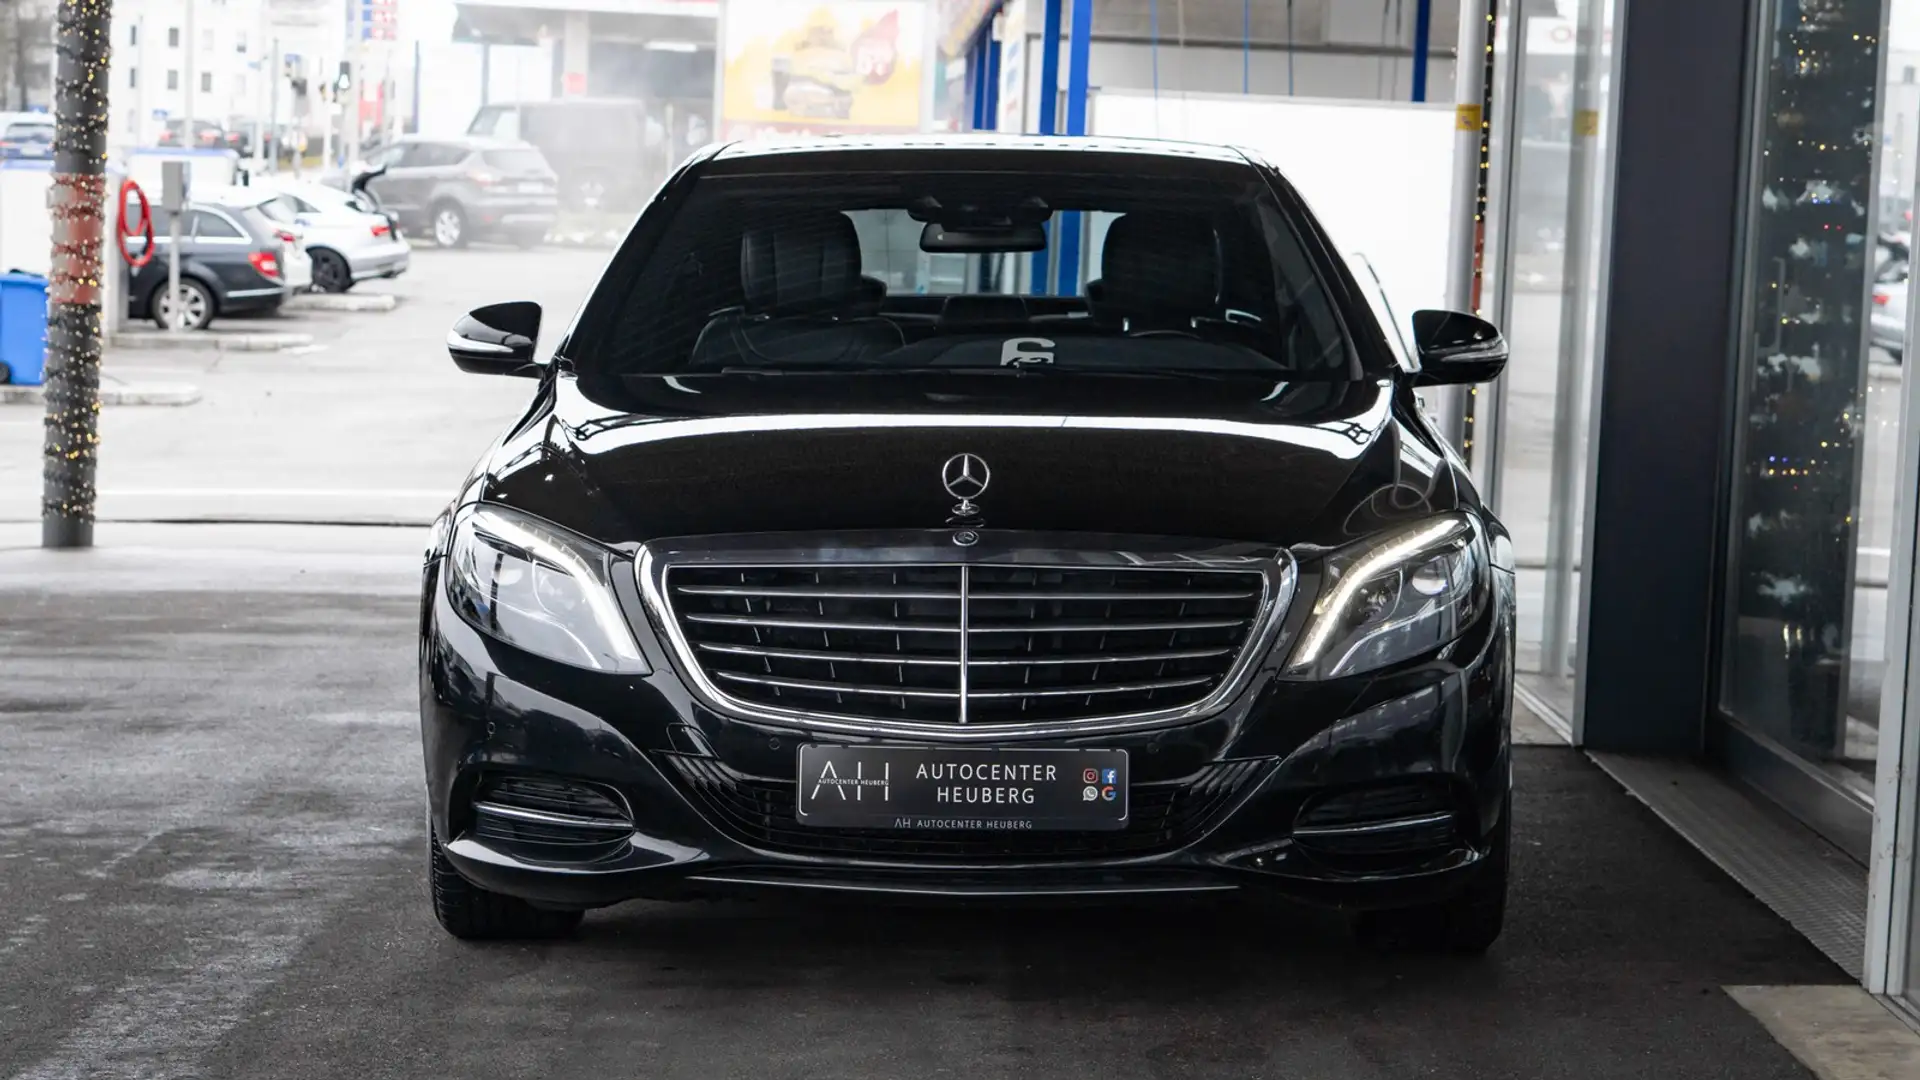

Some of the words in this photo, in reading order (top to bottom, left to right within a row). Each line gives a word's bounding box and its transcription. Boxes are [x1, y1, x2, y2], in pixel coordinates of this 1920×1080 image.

[811, 760, 890, 802] AH
[916, 763, 1056, 781] AUTOCENTER
[818, 778, 858, 786] AUTOCENTER
[860, 779, 890, 787] HEUBERG
[937, 786, 1035, 804] HEUBERG
[916, 819, 982, 829] AUTOCENTER
[986, 820, 1033, 830] HEUBERG
